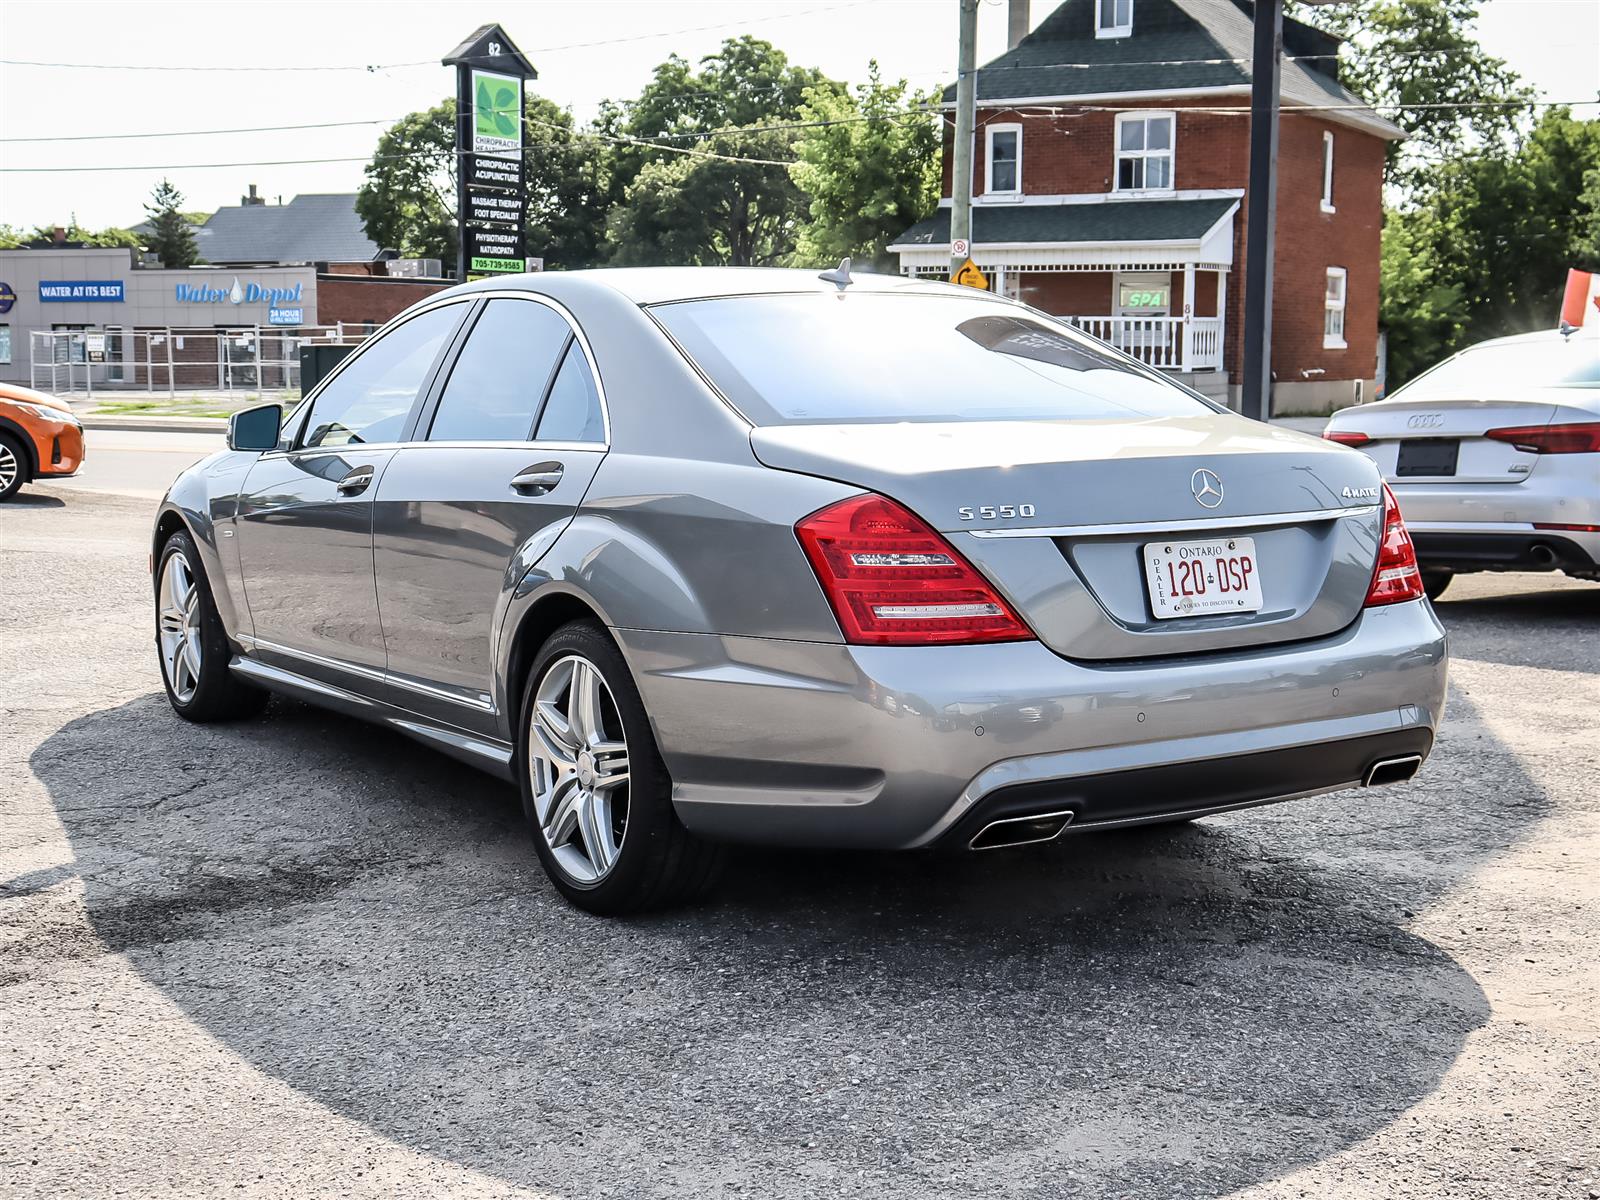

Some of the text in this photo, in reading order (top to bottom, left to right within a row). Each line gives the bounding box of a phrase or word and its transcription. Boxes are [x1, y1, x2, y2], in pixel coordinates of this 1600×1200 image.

[488, 42, 501, 56] 82
[475, 136, 519, 147] CHIROPRACTIC
[475, 159, 520, 172] CHIROPRACTIC
[475, 170, 520, 183] ACUPUNCTURE
[471, 197, 522, 209] MASSAGE THERAPY
[474, 209, 520, 220] FOOT SPECIALIST
[475, 233, 518, 243] PHYSIOTHERAPY
[480, 245, 514, 255] NATUROPATH
[474, 259, 521, 270] 705-739-9585
[40, 286, 121, 297] WATER AT ITS BEST
[175, 281, 303, 307] Water Depot
[1129, 292, 1163, 307] SPA
[280, 309, 299, 317] HOUR
[1341, 486, 1379, 499] 4MATIC
[957, 504, 1036, 521] S 550
[1153, 558, 1166, 606] DEALER
[1167, 556, 1253, 597] 120 DSP
[1210, 599, 1234, 607] DISCOVER
